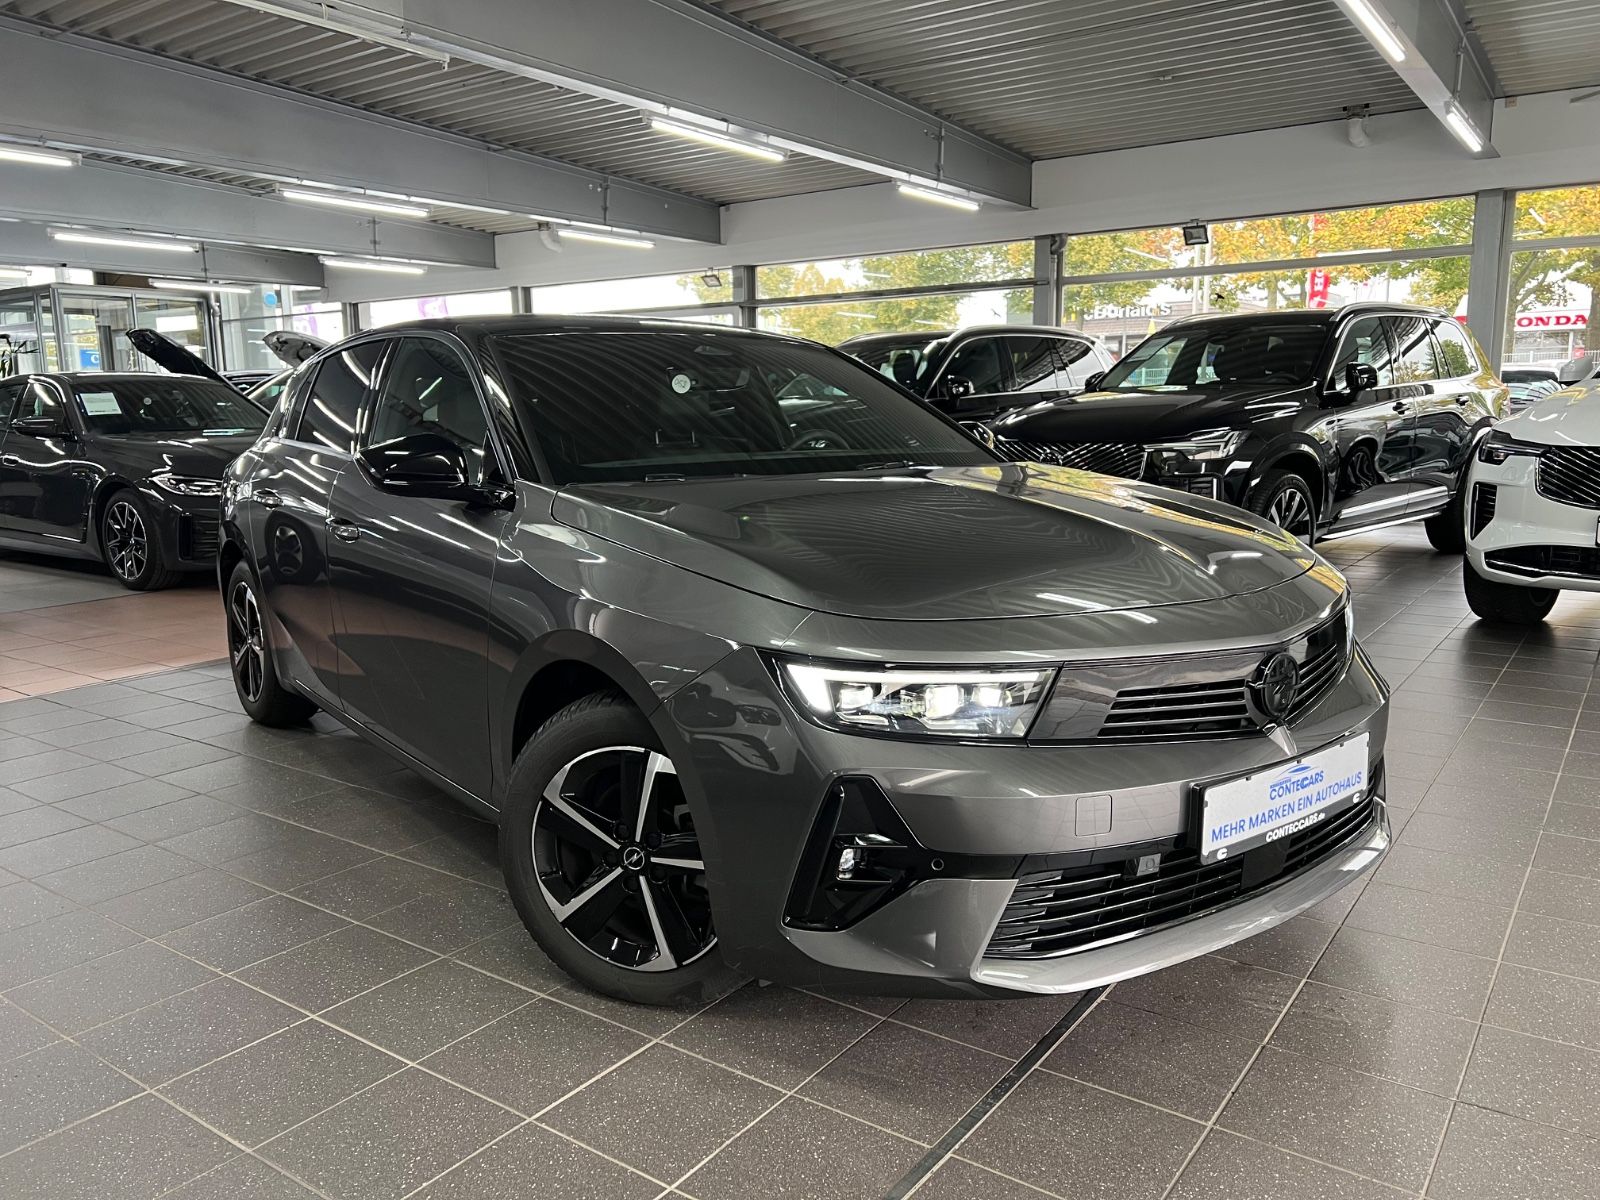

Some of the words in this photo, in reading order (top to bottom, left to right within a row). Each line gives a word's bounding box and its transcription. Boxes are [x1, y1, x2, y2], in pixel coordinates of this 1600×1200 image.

[1516, 314, 1589, 328] ONDA
[1211, 819, 1246, 842] MEHR
[1248, 801, 1295, 830] MARKEN
[1297, 794, 1313, 812] EIN
[1315, 771, 1362, 805] AUTOHAUS
[1265, 812, 1326, 842] CONTECCARS.de
